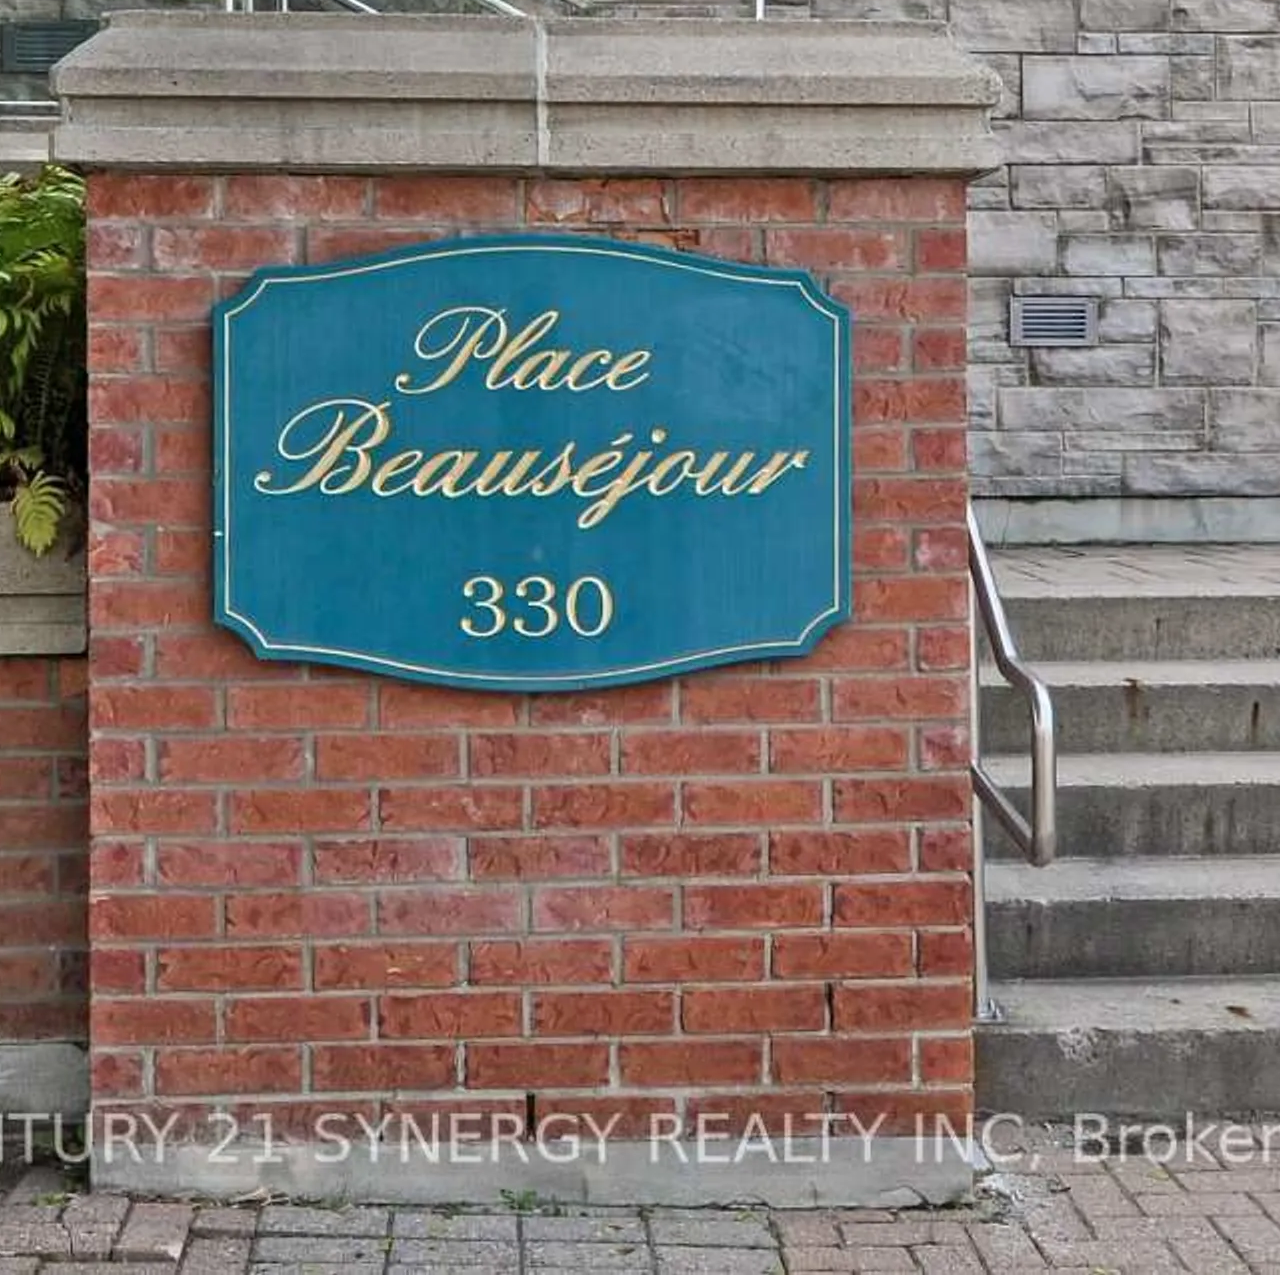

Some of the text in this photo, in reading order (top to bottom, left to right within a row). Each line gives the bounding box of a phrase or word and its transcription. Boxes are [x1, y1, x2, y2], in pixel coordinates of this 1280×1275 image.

[394, 305, 651, 394] Place
[254, 398, 810, 529] Beauséjour
[460, 576, 614, 637] 330
